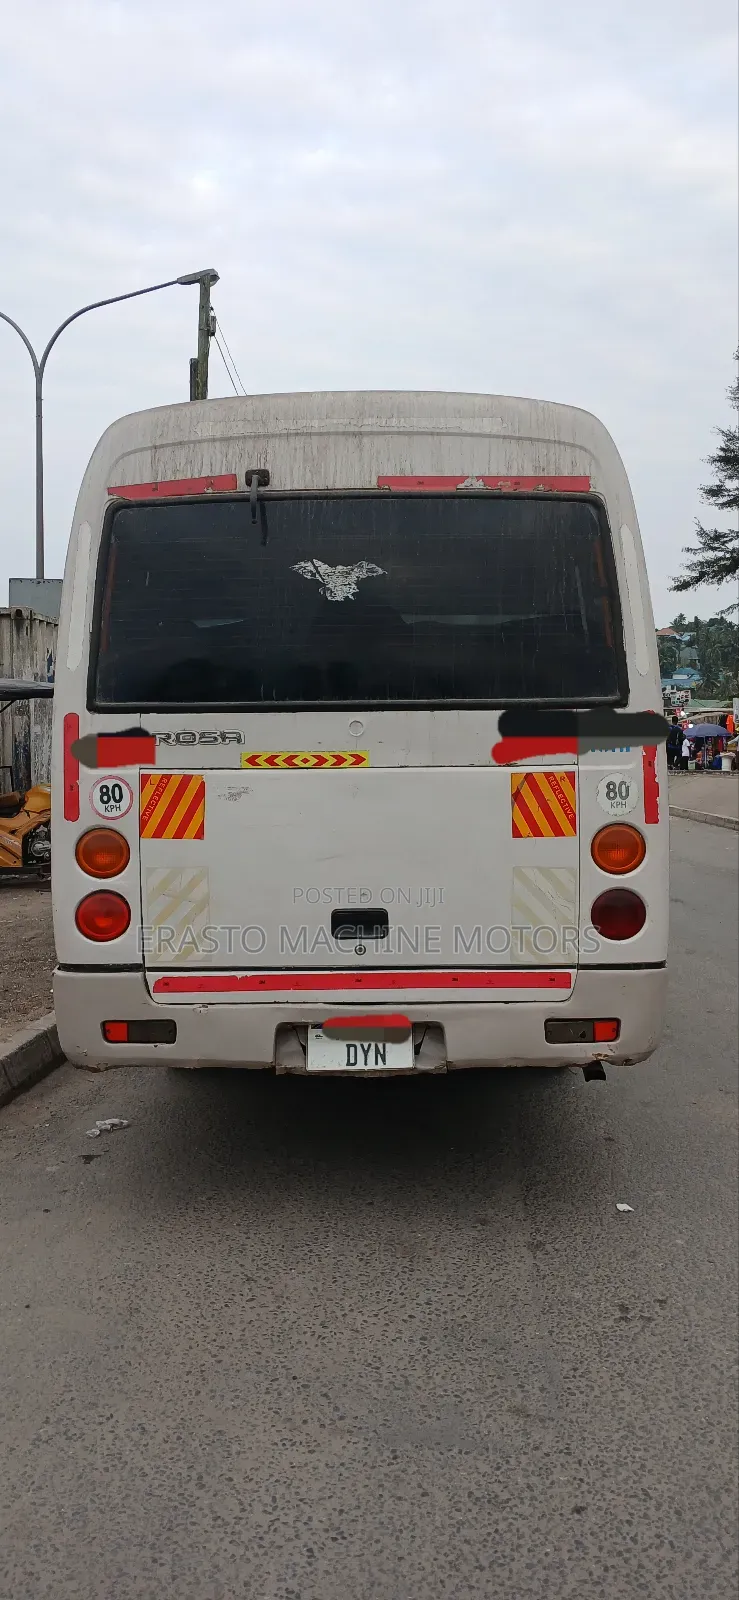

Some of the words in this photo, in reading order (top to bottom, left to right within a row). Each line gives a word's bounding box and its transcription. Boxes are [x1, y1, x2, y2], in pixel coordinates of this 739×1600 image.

[151, 729, 245, 746] ROSA
[99, 783, 123, 804] 80
[142, 777, 168, 821] REFLECTIVE
[548, 775, 575, 820] REFLECTIVE
[605, 780, 630, 801] 80
[104, 804, 121, 812] KPH
[610, 801, 627, 809] KPH
[345, 1043, 387, 1066] DYN
